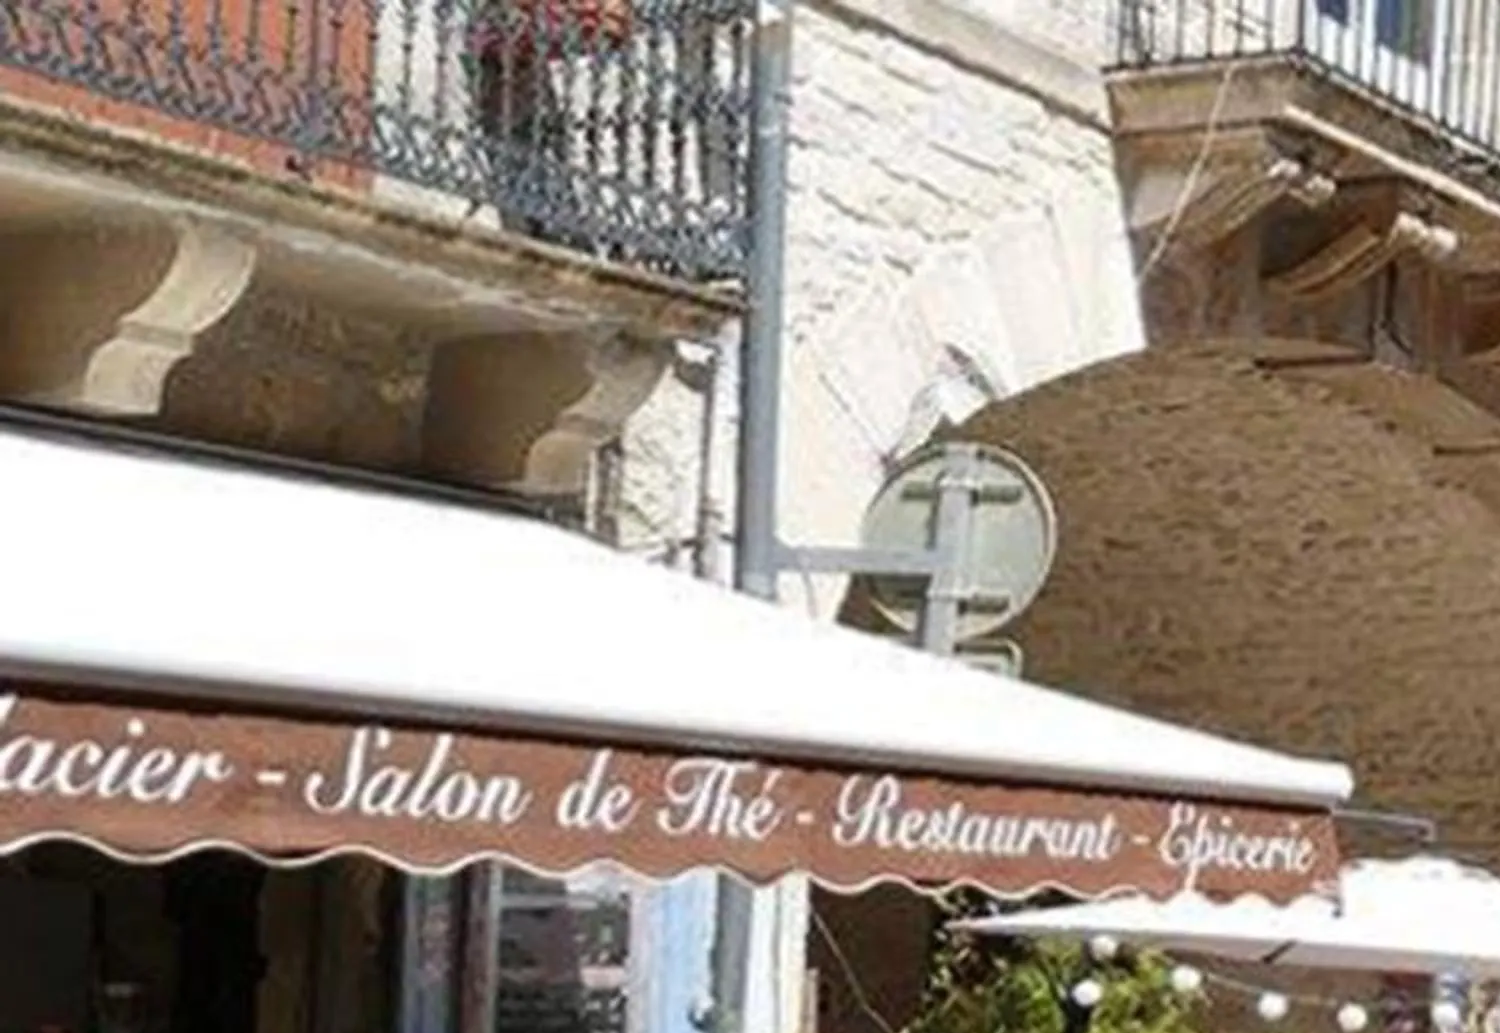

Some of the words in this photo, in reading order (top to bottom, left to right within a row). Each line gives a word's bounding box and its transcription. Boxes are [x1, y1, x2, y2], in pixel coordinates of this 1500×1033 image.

[0, 693, 234, 803] acier
[304, 727, 534, 824] Salon
[557, 749, 646, 831] de
[655, 757, 781, 840] Thé
[832, 772, 1123, 860] Restaurant
